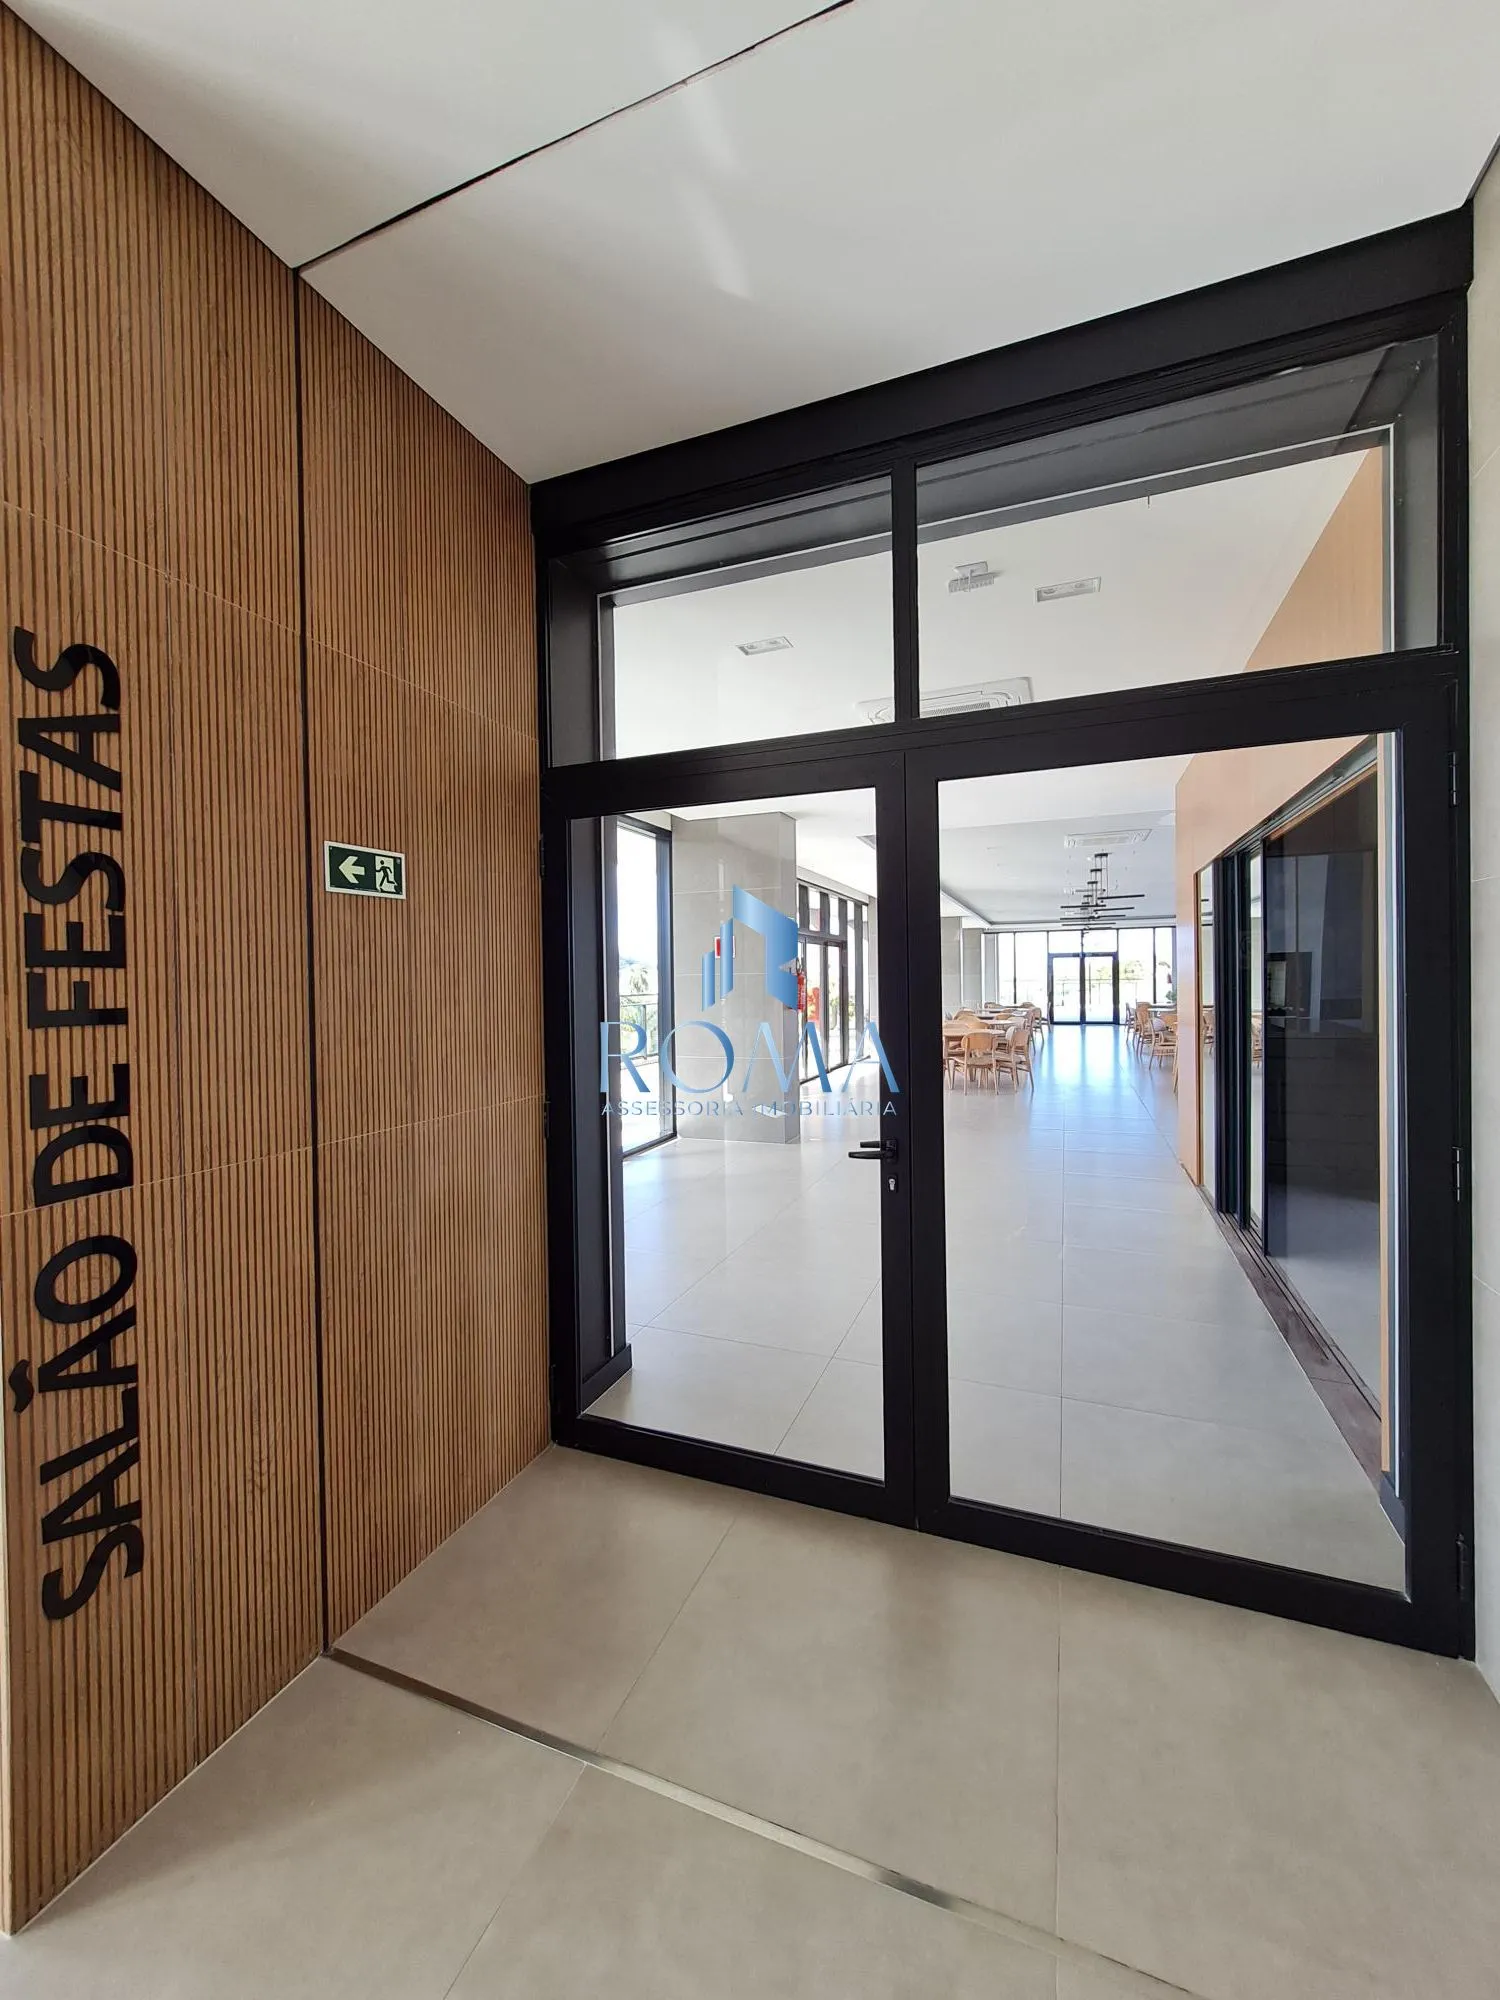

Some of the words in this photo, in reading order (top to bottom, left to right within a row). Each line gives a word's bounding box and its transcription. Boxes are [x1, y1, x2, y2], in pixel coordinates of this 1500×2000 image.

[14, 626, 129, 1029] FESTAS
[29, 1063, 134, 1208] DE
[8, 1234, 144, 1621] SALÃO
